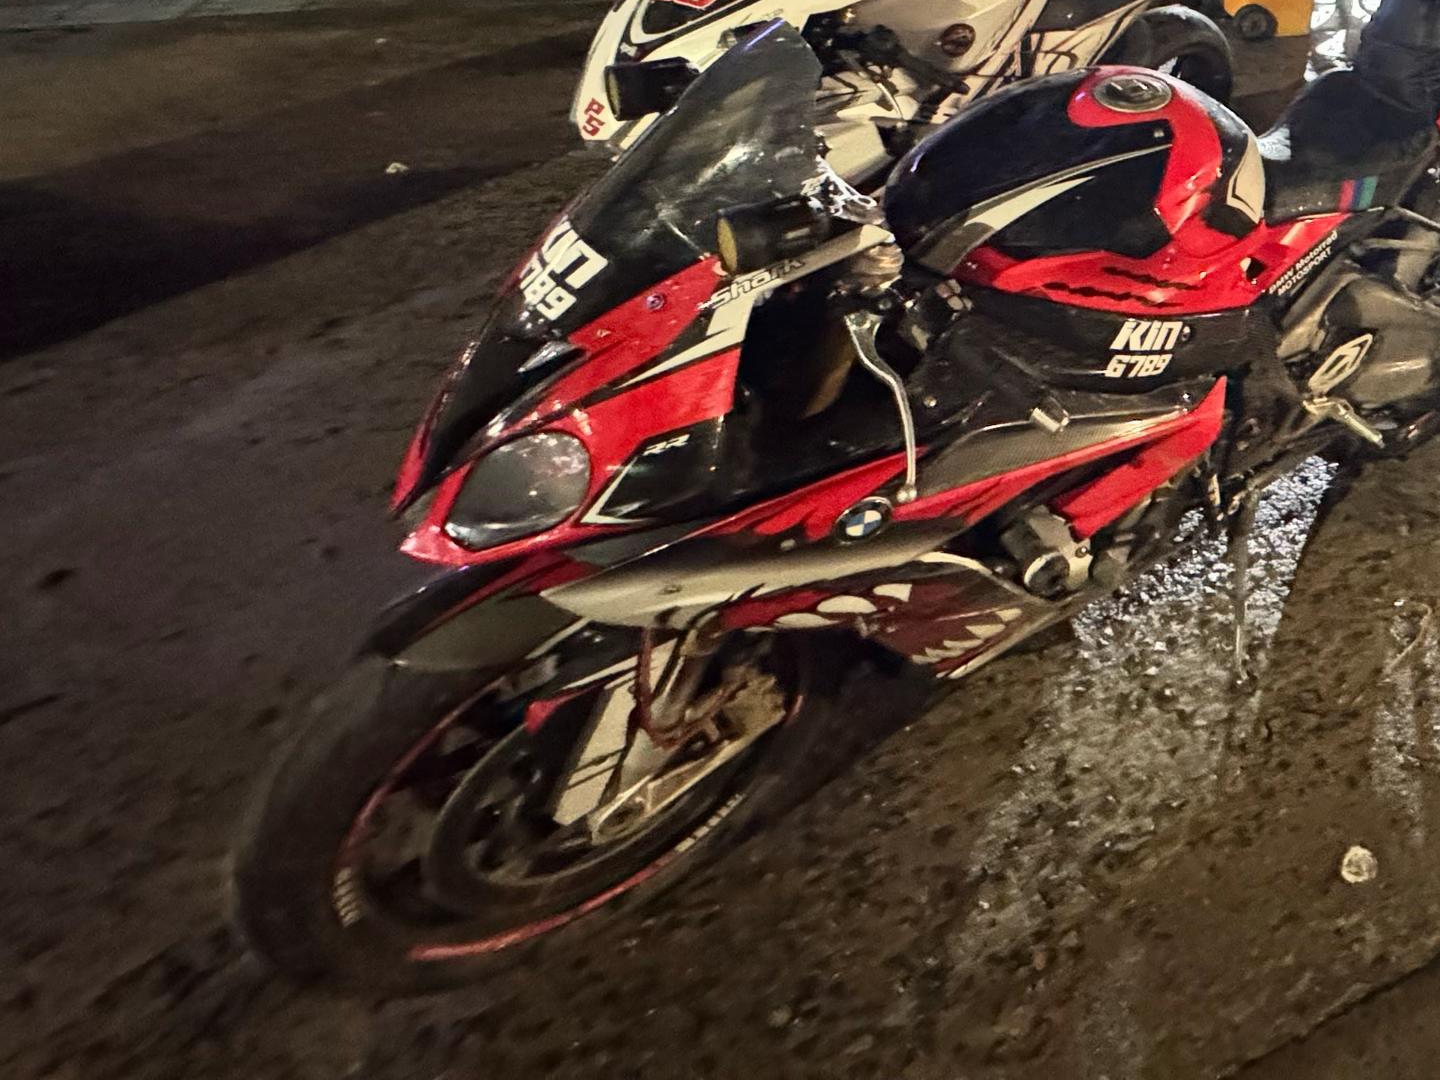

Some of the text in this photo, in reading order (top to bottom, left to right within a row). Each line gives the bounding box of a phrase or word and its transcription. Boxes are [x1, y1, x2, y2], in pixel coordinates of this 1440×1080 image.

[1295, 230, 1338, 271] Motorrad
[519, 251, 577, 321] 789
[1104, 353, 1173, 378] 6789
